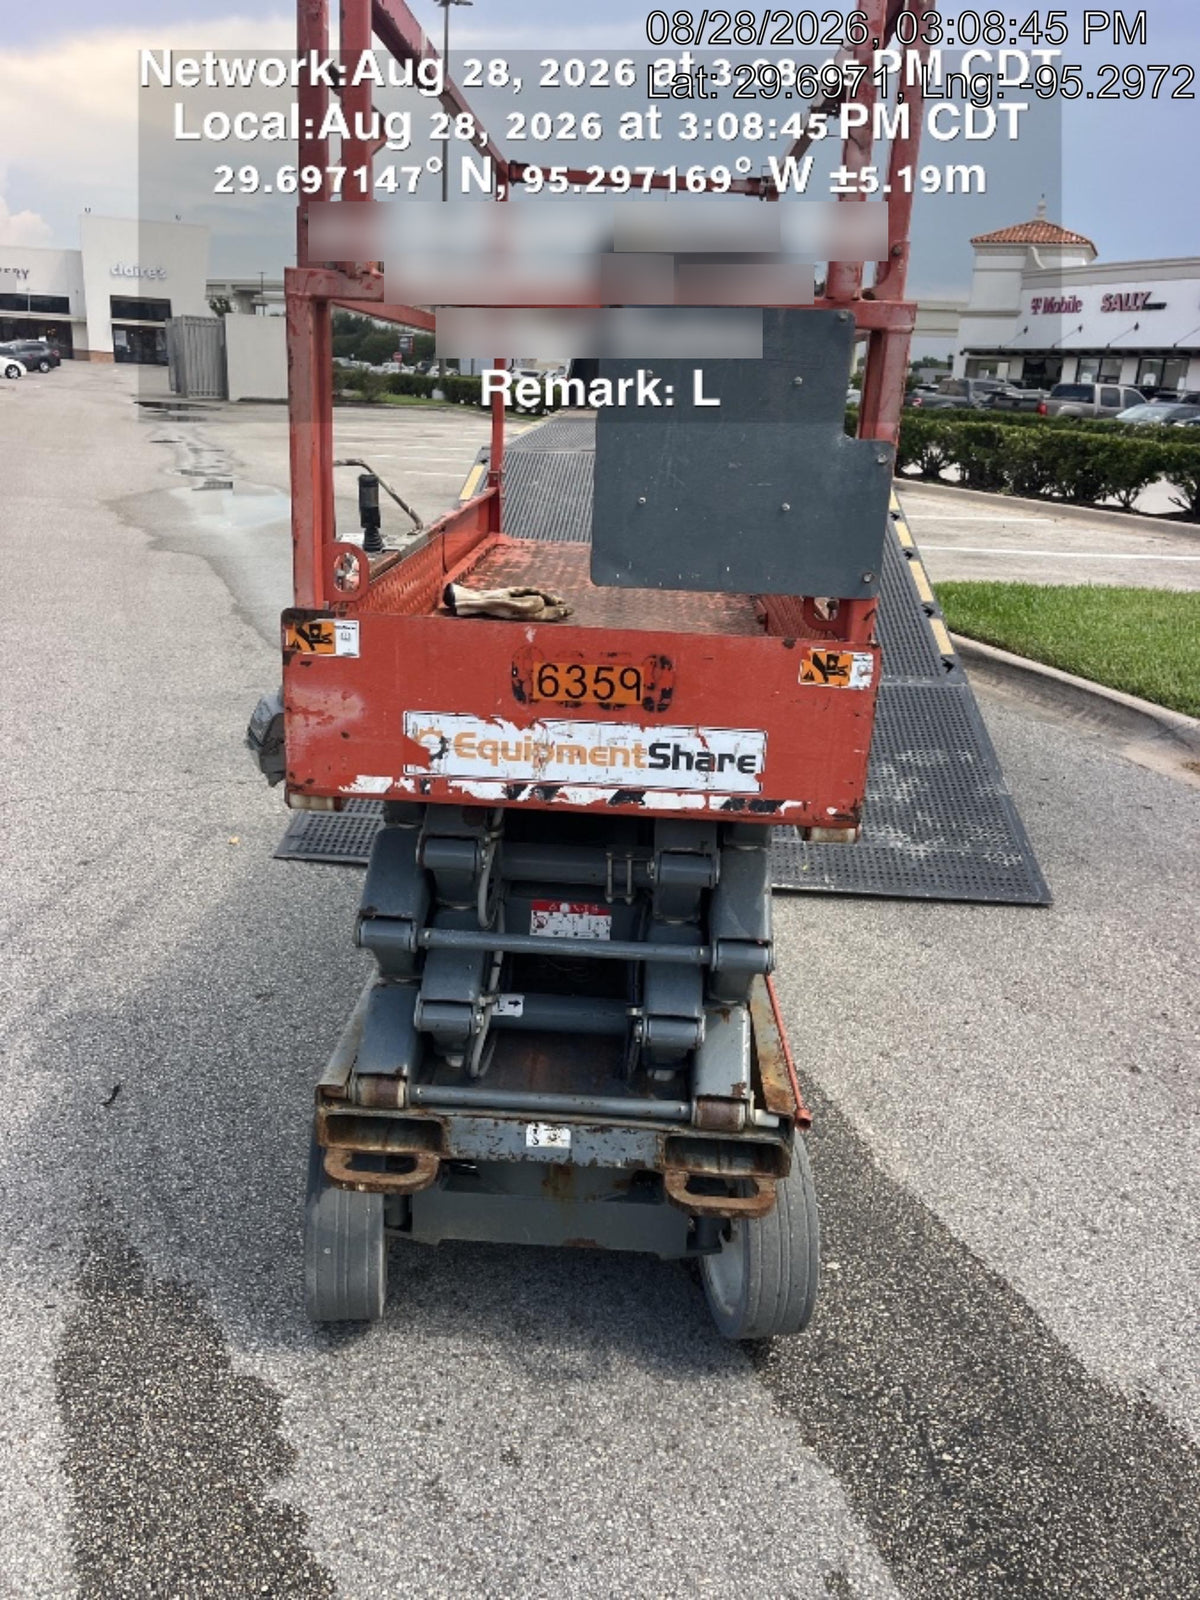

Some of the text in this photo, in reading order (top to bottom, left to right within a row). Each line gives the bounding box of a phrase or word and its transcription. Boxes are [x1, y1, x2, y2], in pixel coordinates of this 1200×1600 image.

[1101, 292, 1152, 313] SALLY
[537, 663, 641, 702] 6359
[454, 731, 757, 775] EquipmentShare
